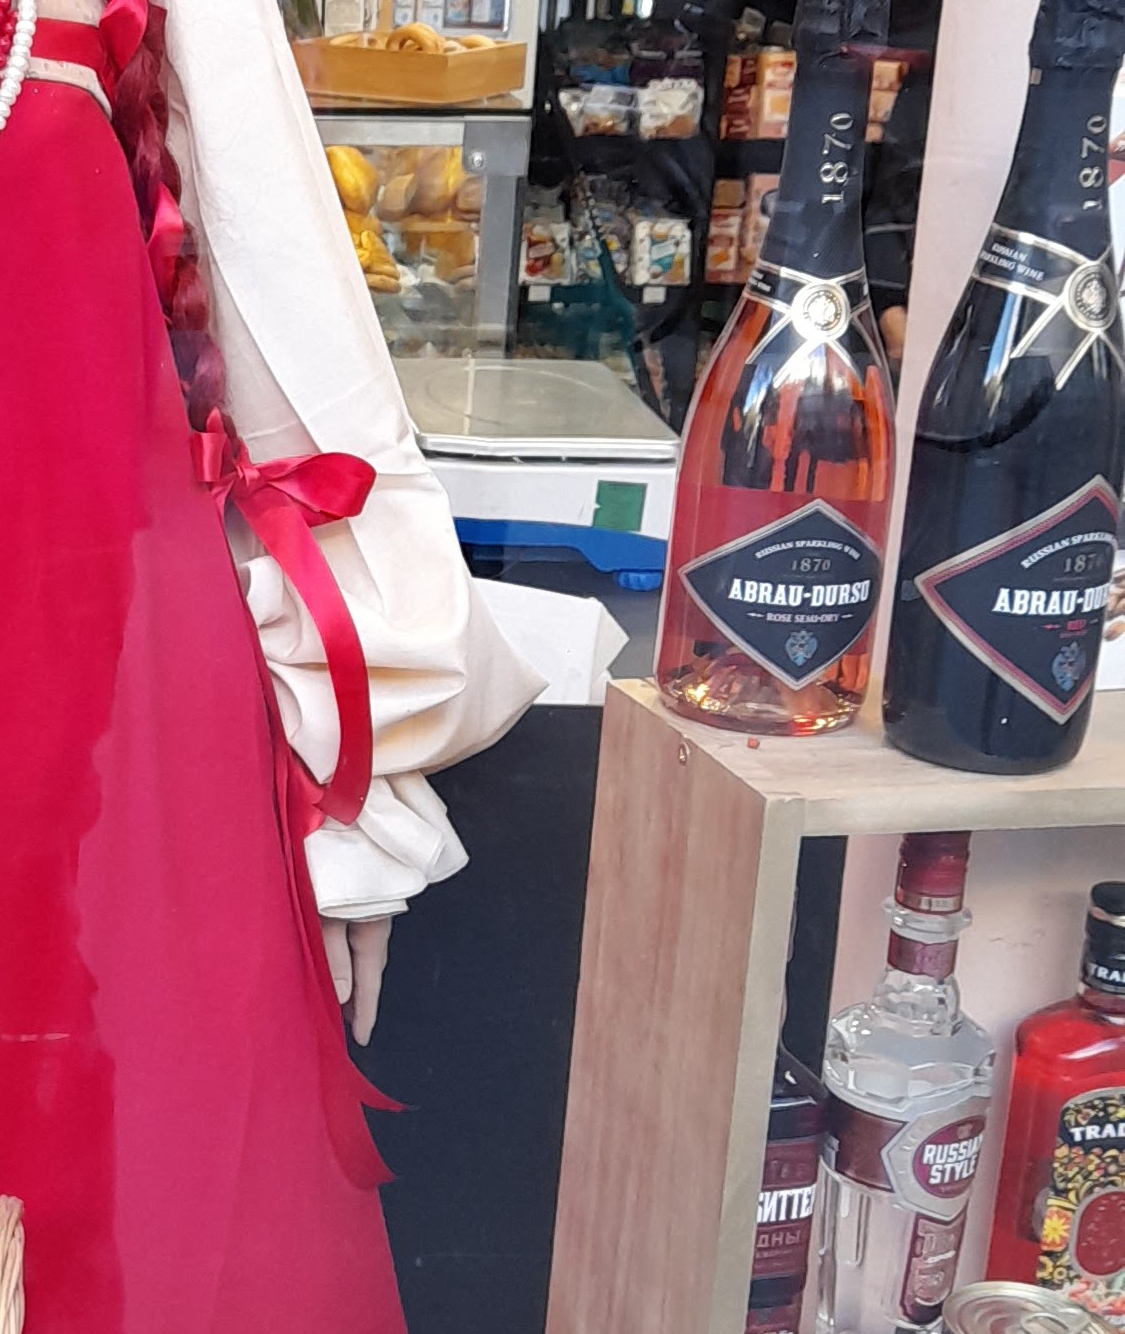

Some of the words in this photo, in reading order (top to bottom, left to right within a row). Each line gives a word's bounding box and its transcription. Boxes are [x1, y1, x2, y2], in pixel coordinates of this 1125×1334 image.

[819, 112, 854, 204] 1870
[1079, 115, 1107, 211] 1870
[791, 557, 832, 573] 1870
